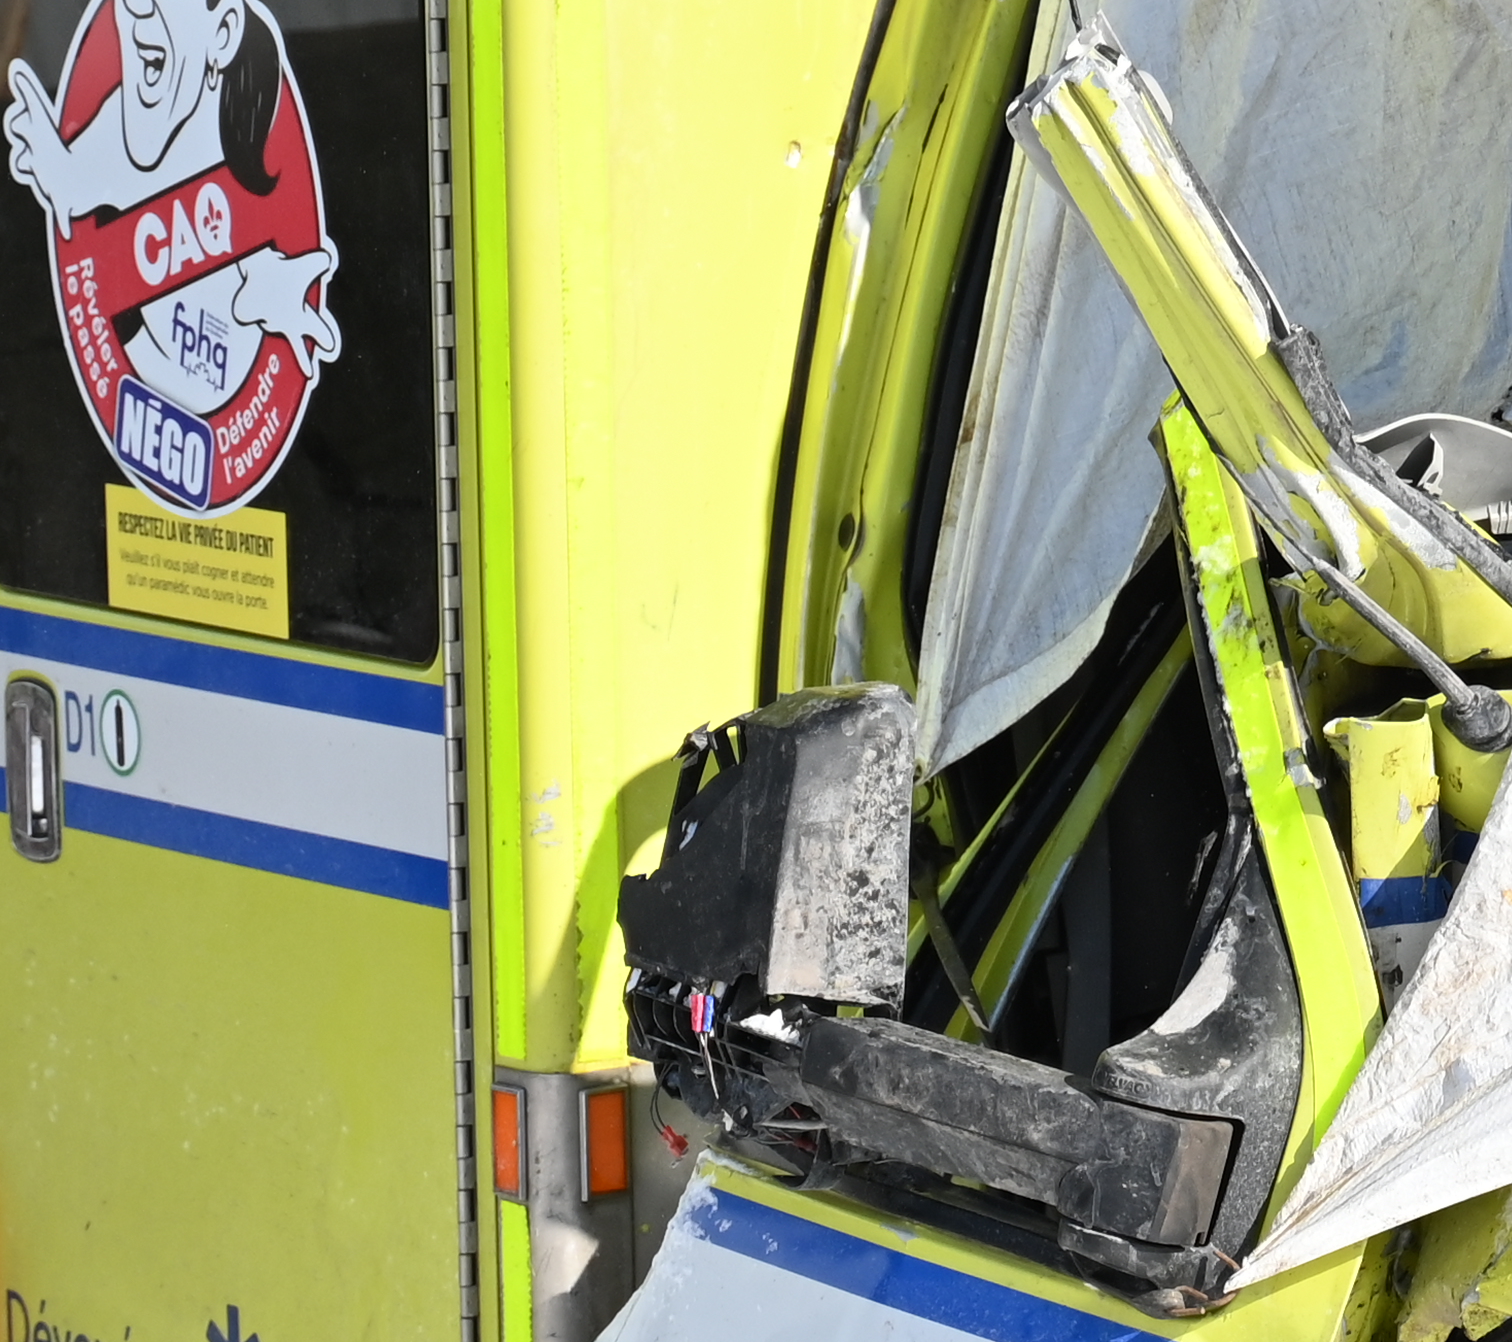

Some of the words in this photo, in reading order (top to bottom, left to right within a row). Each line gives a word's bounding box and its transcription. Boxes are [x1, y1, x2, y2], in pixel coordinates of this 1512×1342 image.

[65, 263, 79, 295] le
[134, 182, 234, 286] CAQ
[69, 303, 110, 398] passé
[80, 257, 118, 372] Révéler
[172, 301, 228, 391] fphq
[120, 391, 206, 496] NÉGO
[216, 353, 280, 454] Défendre
[223, 406, 281, 485] l'avenir
[118, 511, 164, 540] RESPECTEZ
[166, 519, 177, 541] LA
[178, 521, 192, 545] VIE
[194, 523, 223, 550] PRIVÉE
[226, 529, 237, 552] DU
[239, 532, 274, 558] PATIENT
[65, 689, 96, 757] D1
